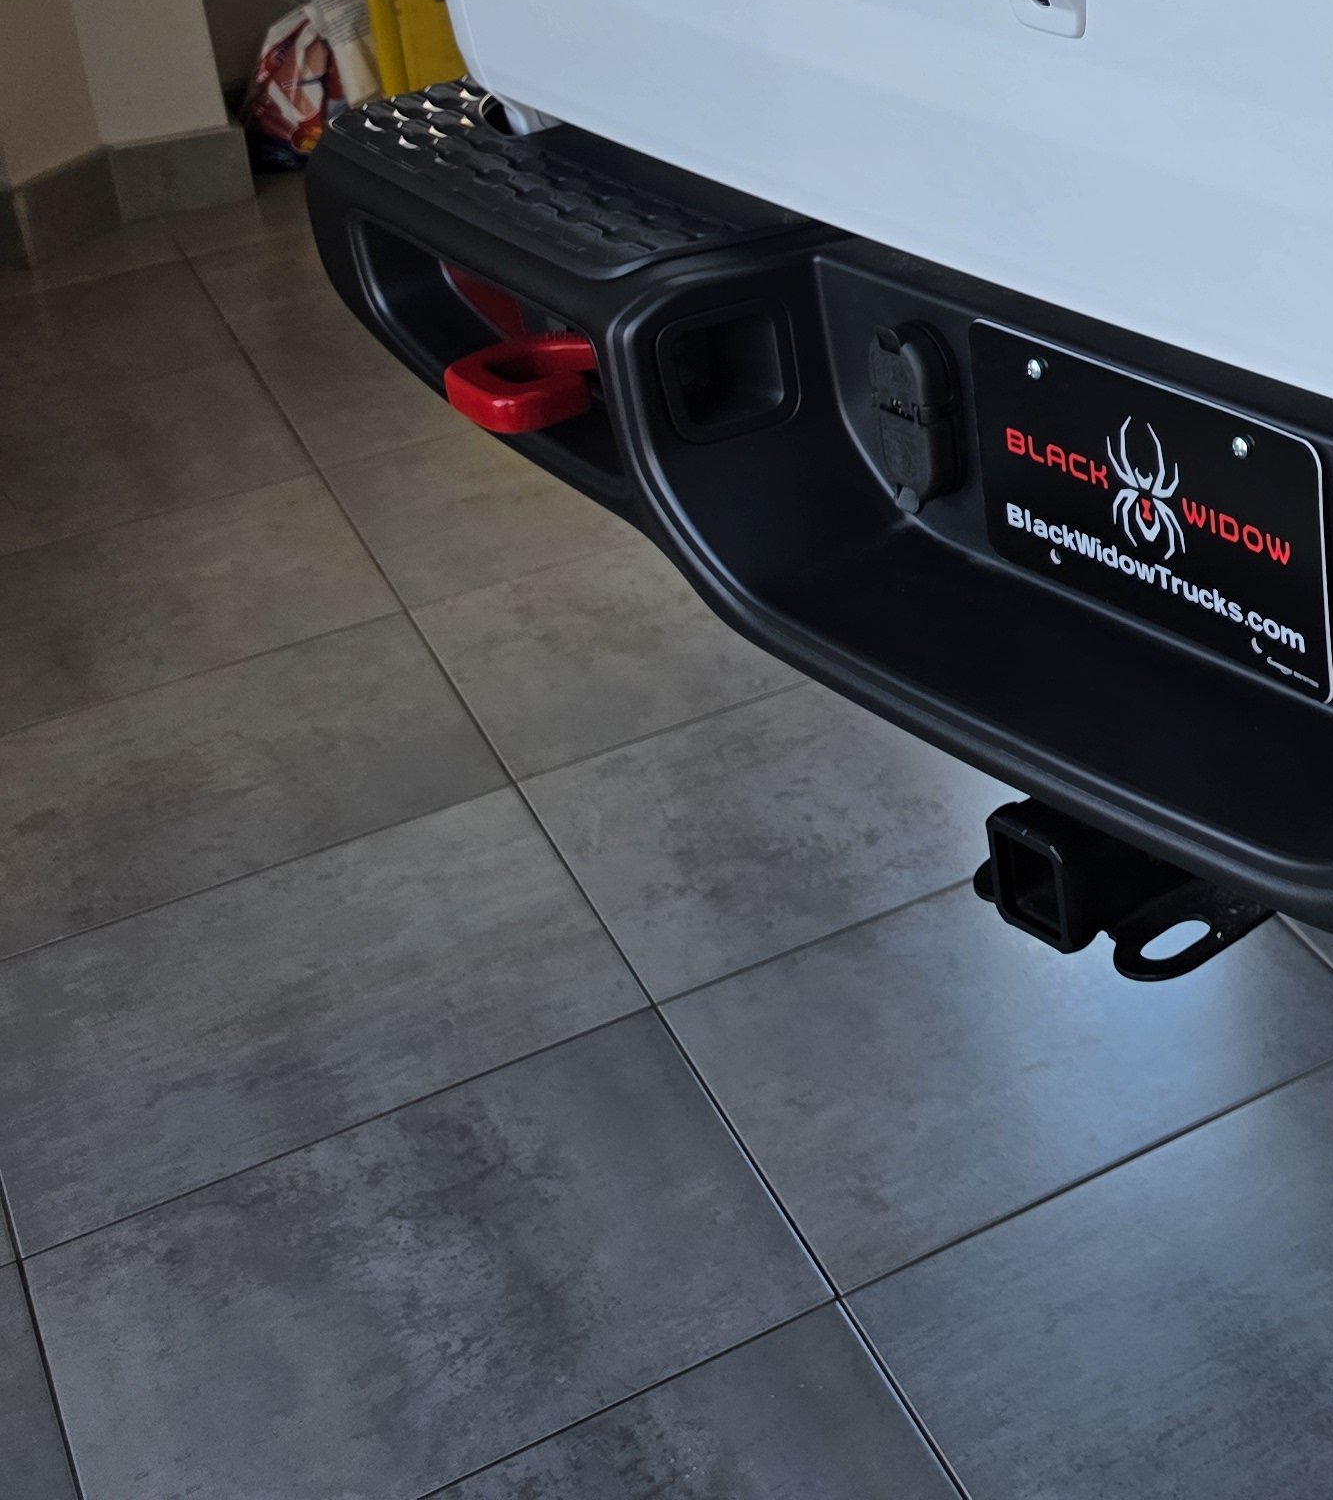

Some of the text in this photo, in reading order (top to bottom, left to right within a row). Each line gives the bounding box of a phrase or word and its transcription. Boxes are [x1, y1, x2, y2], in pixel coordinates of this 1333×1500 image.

[1005, 427, 1292, 566] BLACK WIDOW
[1005, 502, 1306, 654] BlackWidowTrucks.com
